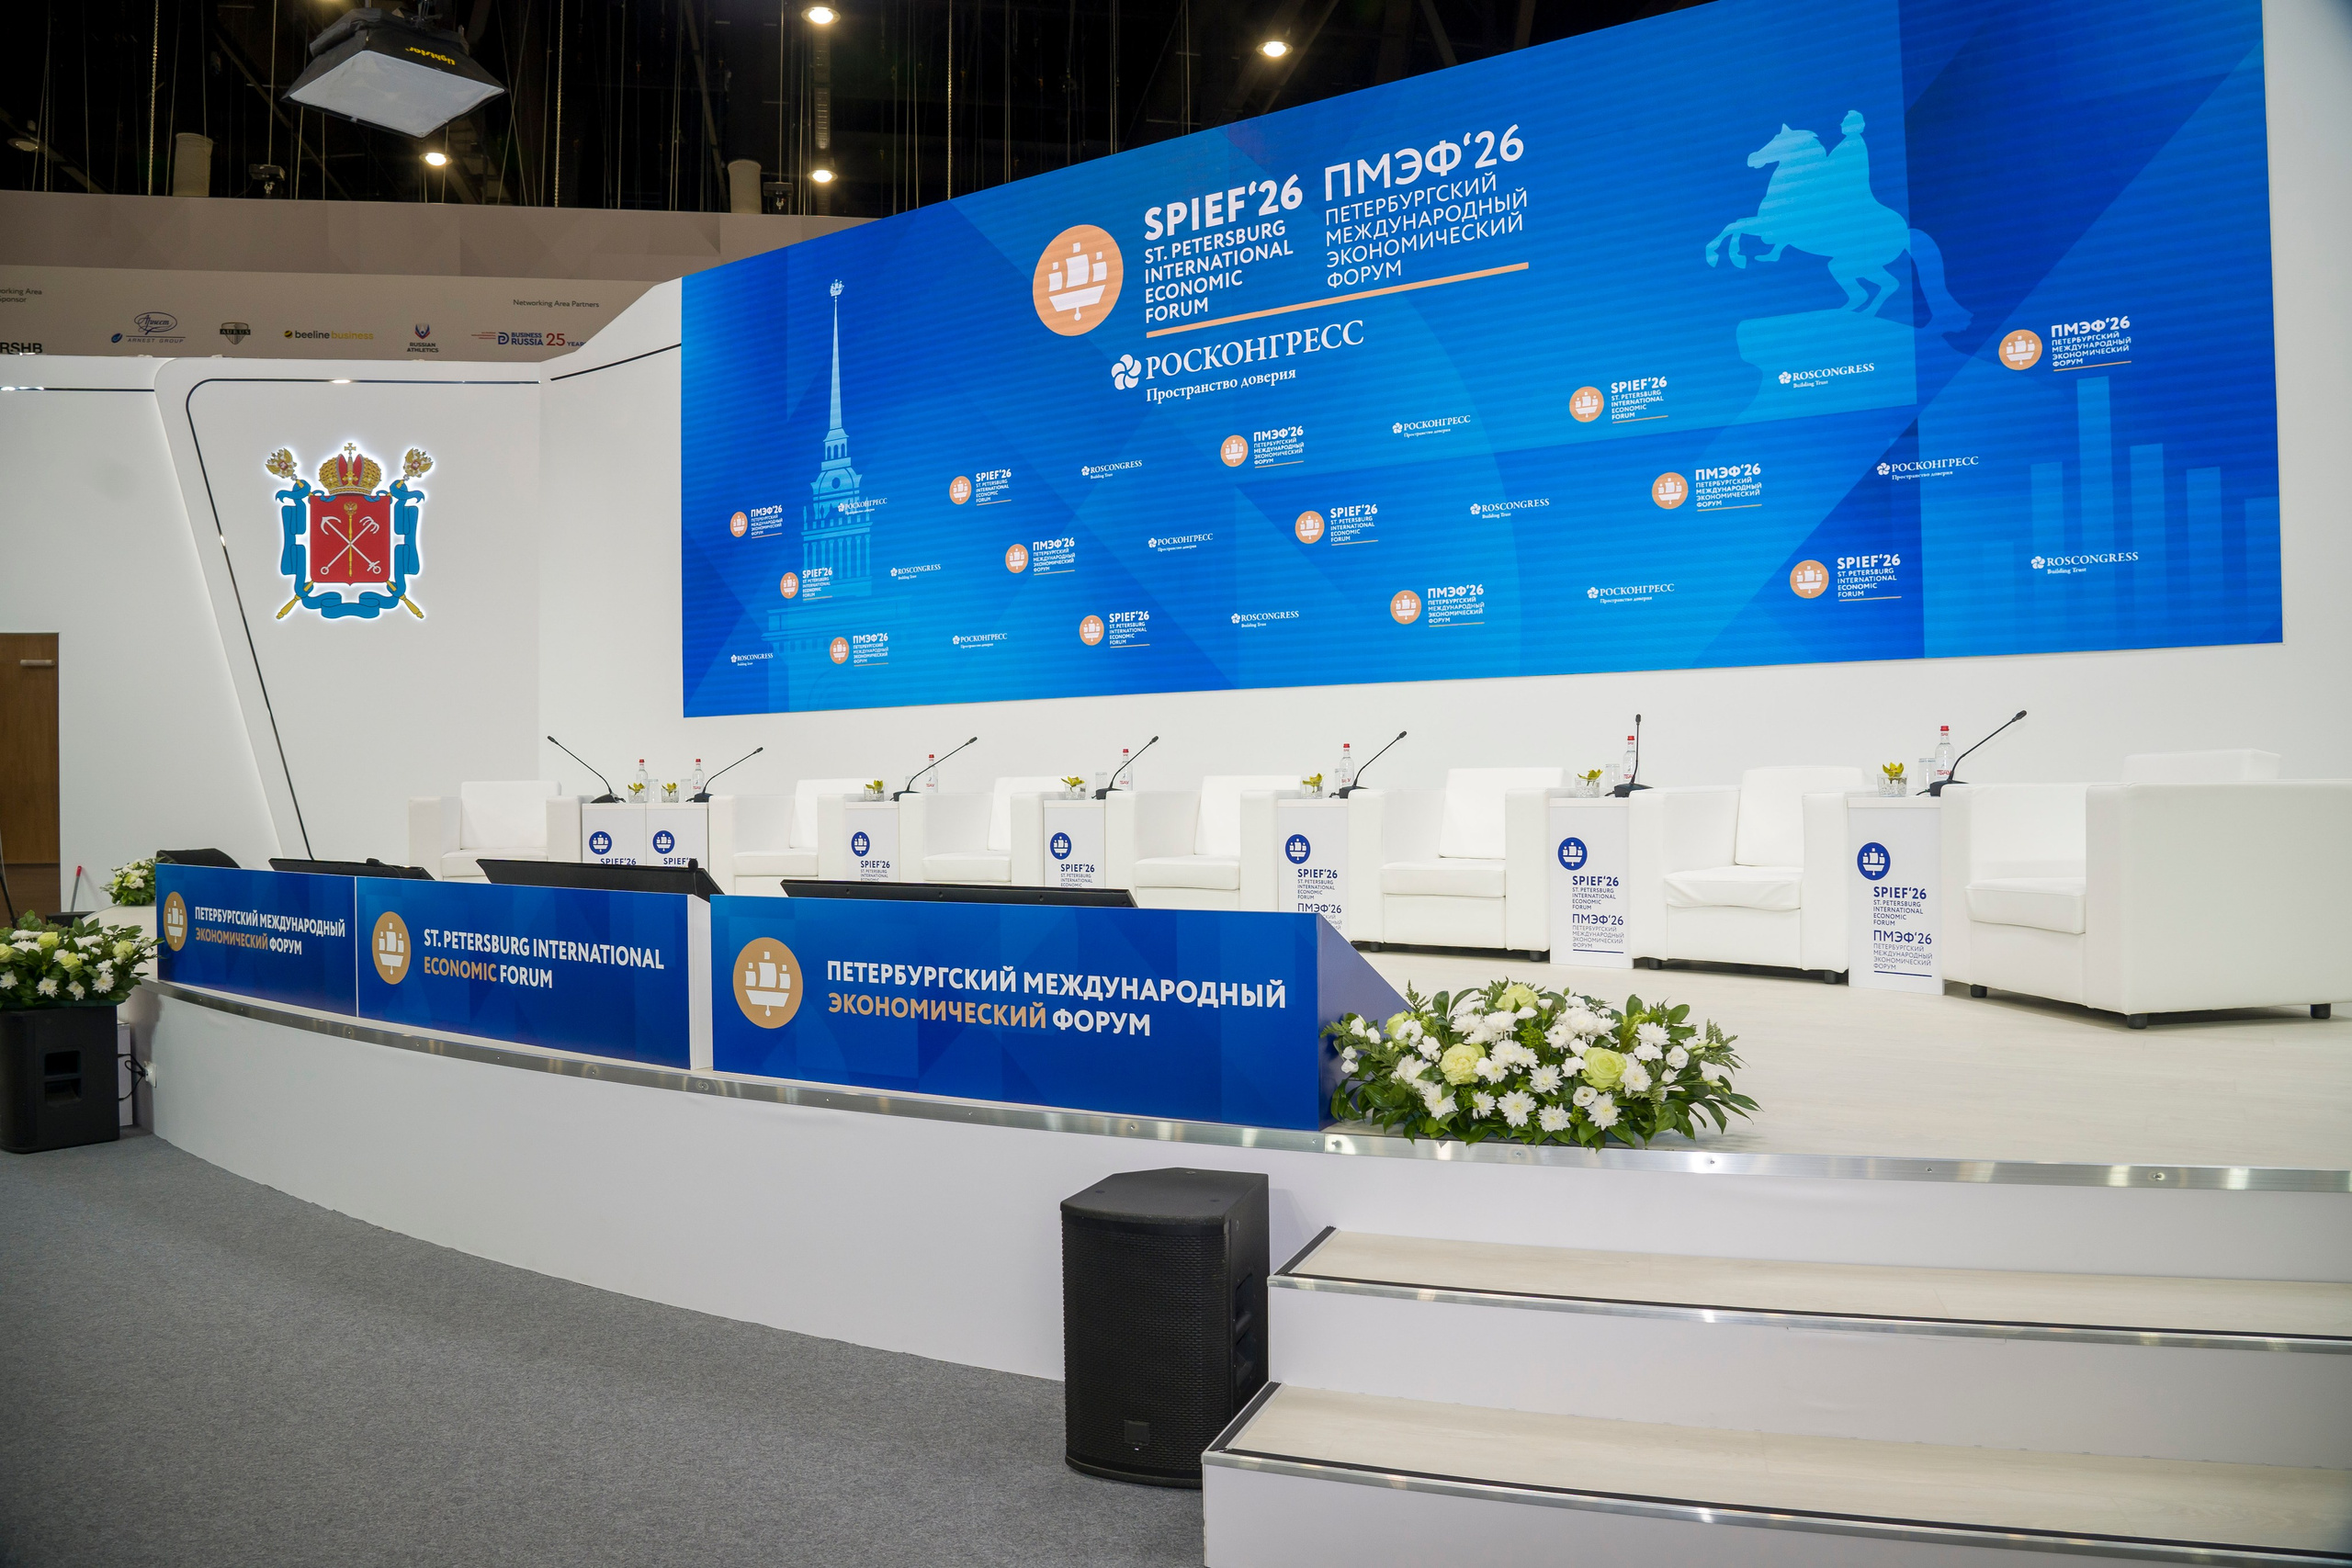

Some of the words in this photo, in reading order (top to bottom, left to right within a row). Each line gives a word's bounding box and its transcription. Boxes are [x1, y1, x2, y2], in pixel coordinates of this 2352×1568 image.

[1326, 171, 1496, 226] ПЕТЕРБУРГСКИЙ
[1326, 187, 1527, 247] МЕЖДУНАРОДНЫЙ
[1145, 246, 1167, 264] ST.
[1172, 220, 1285, 258] PETERSBURG
[1327, 211, 1523, 268] ЭКОНОМИЧЕСКИЙ
[1145, 240, 1293, 284] INTERNATIONAL
[1327, 260, 1402, 288] ФОРУМ
[1145, 270, 1243, 304] ECONOMIC
[1146, 297, 1208, 324] FORUM
[295, 330, 330, 339] beeline
[331, 331, 374, 340] business
[546, 333, 565, 346] 25
[2052, 331, 2120, 346] ПЕТЕРБУРГСКИЙ
[1146, 320, 1364, 379] РОСКОНГРЕСС
[2052, 337, 2131, 353] МЕЖДУНАРОДНЫЙ
[2052, 344, 2129, 360] ЭКОНОМИЧЕСКИЙ
[2052, 358, 2083, 367] ФОРУМ
[1793, 363, 1874, 381] ROSCONGRESS
[1147, 378, 1238, 404] Пространство
[1241, 369, 1296, 389] доверия
[1621, 389, 1661, 399] PETERSBURG
[1612, 396, 1664, 407] INTERNATIONAL
[1612, 404, 1646, 413] ECONOMIC
[1404, 415, 1470, 431] РОСКОНГРЕСС
[1090, 460, 1142, 473] ROSCONGRESS
[1892, 456, 1979, 472] РОСКОНГРЕСС
[1696, 477, 1752, 488] ПЕТЕРБУРГСКИЙ
[1696, 482, 1762, 494] МЕЖДУНАРОДНЫЙ
[1696, 489, 1760, 501] ЭКОНОМИЧЕСКИЙ
[845, 498, 887, 510] РОСКОНГРЕСС
[1482, 498, 1549, 512] ROSCONGRESS
[1331, 522, 1375, 530] INTERNATIONAL
[1339, 516, 1373, 524] PETERSBURG
[1158, 533, 1213, 545] РОСКОНГРЕСС
[2047, 552, 2138, 566] ROSCONGRESS
[898, 564, 941, 574] ROSCONGRESS
[1849, 568, 1894, 576] PETERSBURG
[1838, 575, 1897, 583] INTERNATIONAL
[1600, 583, 1674, 596] РОСКОНГРЕСС
[1428, 596, 1476, 605] ПЕТЕРБУРГСКИЙ
[1428, 602, 1484, 611] МЕЖДУНАРОДНЫЙ
[1241, 611, 1299, 621] ROSCONGRESS
[1428, 608, 1482, 617] ЭКОНОМИЧЕСКИЙ
[960, 633, 1007, 642] РОСКОНГРЕСС
[738, 653, 773, 661] ROSCONGRESS
[195, 906, 258, 927] ПЕТЕРБУРГСКИЙ
[260, 914, 345, 937] МЕЖДУНАРОДНЫЙ
[196, 928, 268, 950] ЭКОНОМИЧЕСКИЙ
[270, 937, 302, 955] ФОРУМ
[1874, 943, 1924, 952] ПЕТЕРБУРГСКИЙ
[424, 928, 441, 947] ST.
[444, 931, 530, 956] PETERSBURG
[533, 939, 664, 969] INTERNATIONAL
[1874, 950, 1932, 959] МЕЖДУНАРОДНЫЙ
[1874, 956, 1931, 965] ЭКОНОМИЧЕСКИЙ
[424, 956, 497, 981] ECONOMIC
[500, 965, 552, 988] FORUM
[828, 960, 1016, 993] ПЕТЕРБУРГСКИЙ
[1024, 972, 1286, 1008] МЕЖДУНАРОДНЫЙ
[828, 992, 1046, 1028] ЭКОНОМИЧЕСКИЙ
[1052, 1008, 1150, 1036] ФОРУМ
